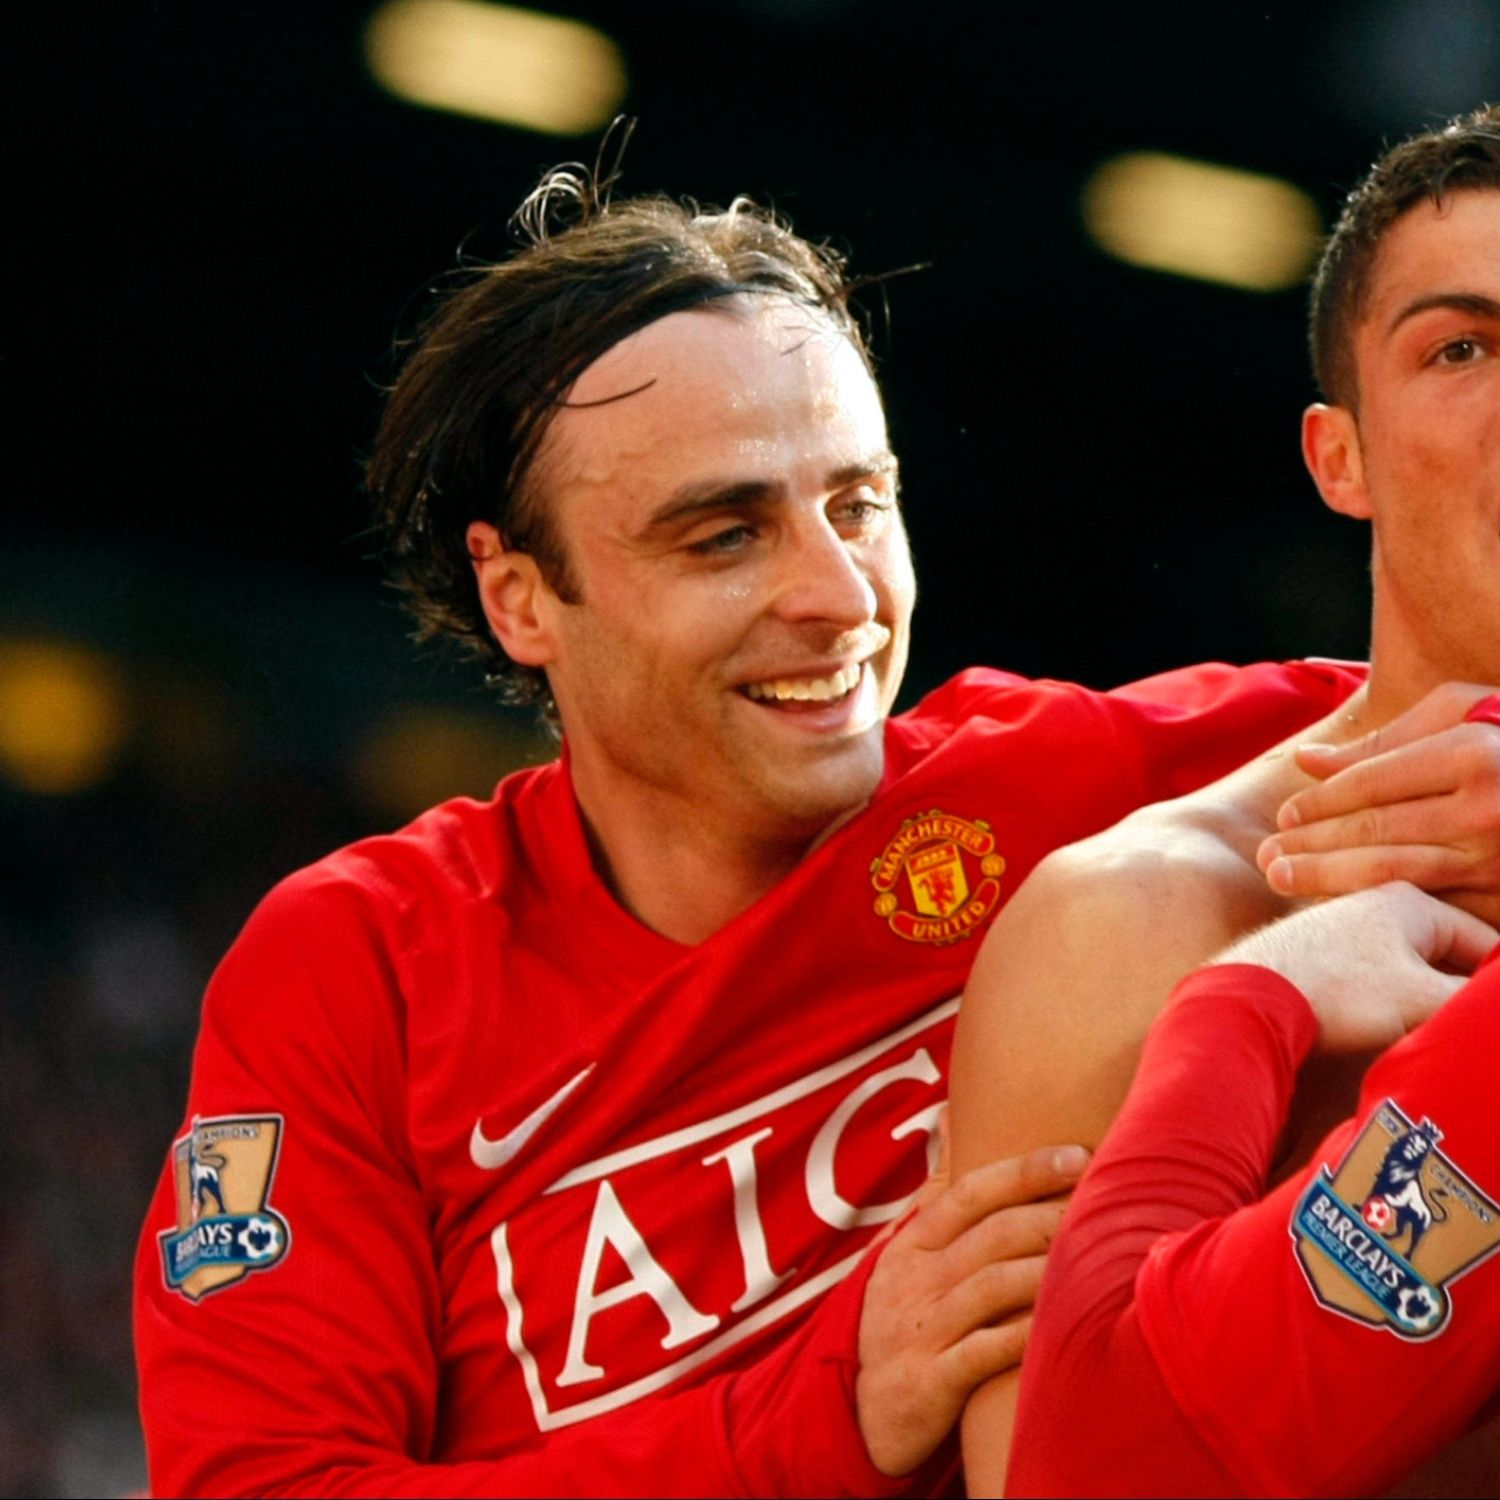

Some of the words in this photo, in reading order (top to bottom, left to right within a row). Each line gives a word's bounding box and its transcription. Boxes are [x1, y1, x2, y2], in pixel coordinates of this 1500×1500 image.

[879, 819, 983, 881] MANCHESTER
[913, 901, 985, 939] UNITED
[555, 1047, 948, 1387] AIG
[1310, 1194, 1406, 1289] BARCLAYS
